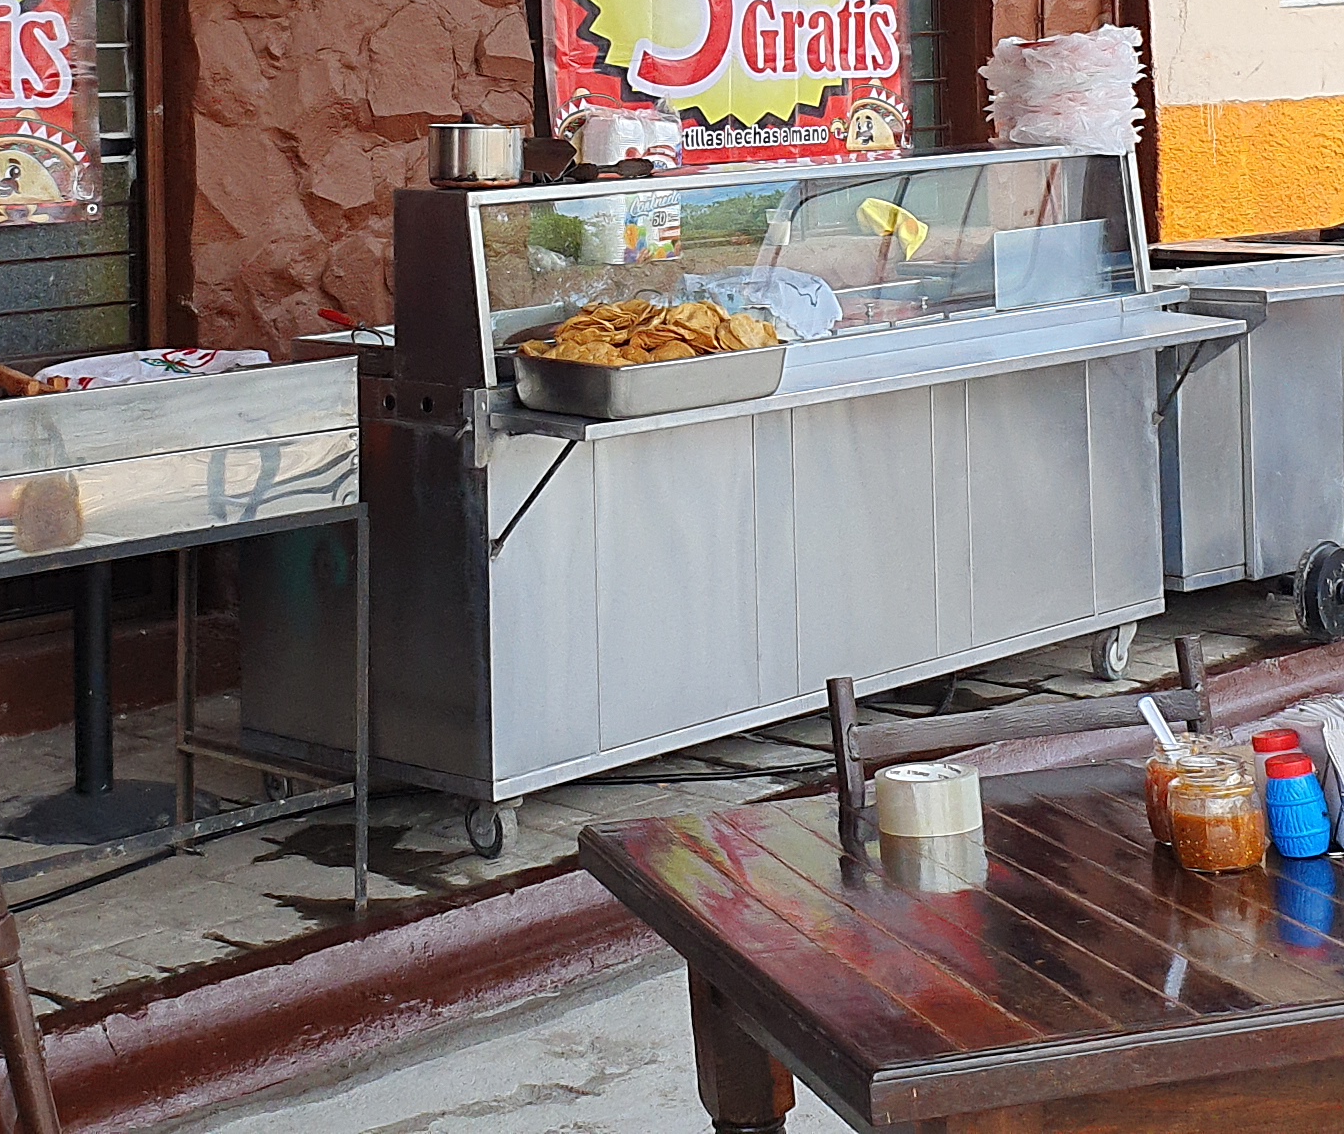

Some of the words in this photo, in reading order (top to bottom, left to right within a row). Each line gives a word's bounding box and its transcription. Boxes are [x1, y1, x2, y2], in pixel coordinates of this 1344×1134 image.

[682, 126, 723, 150] tillas
[725, 124, 780, 148] hechas
[781, 129, 791, 145] a
[791, 126, 829, 145] mano
